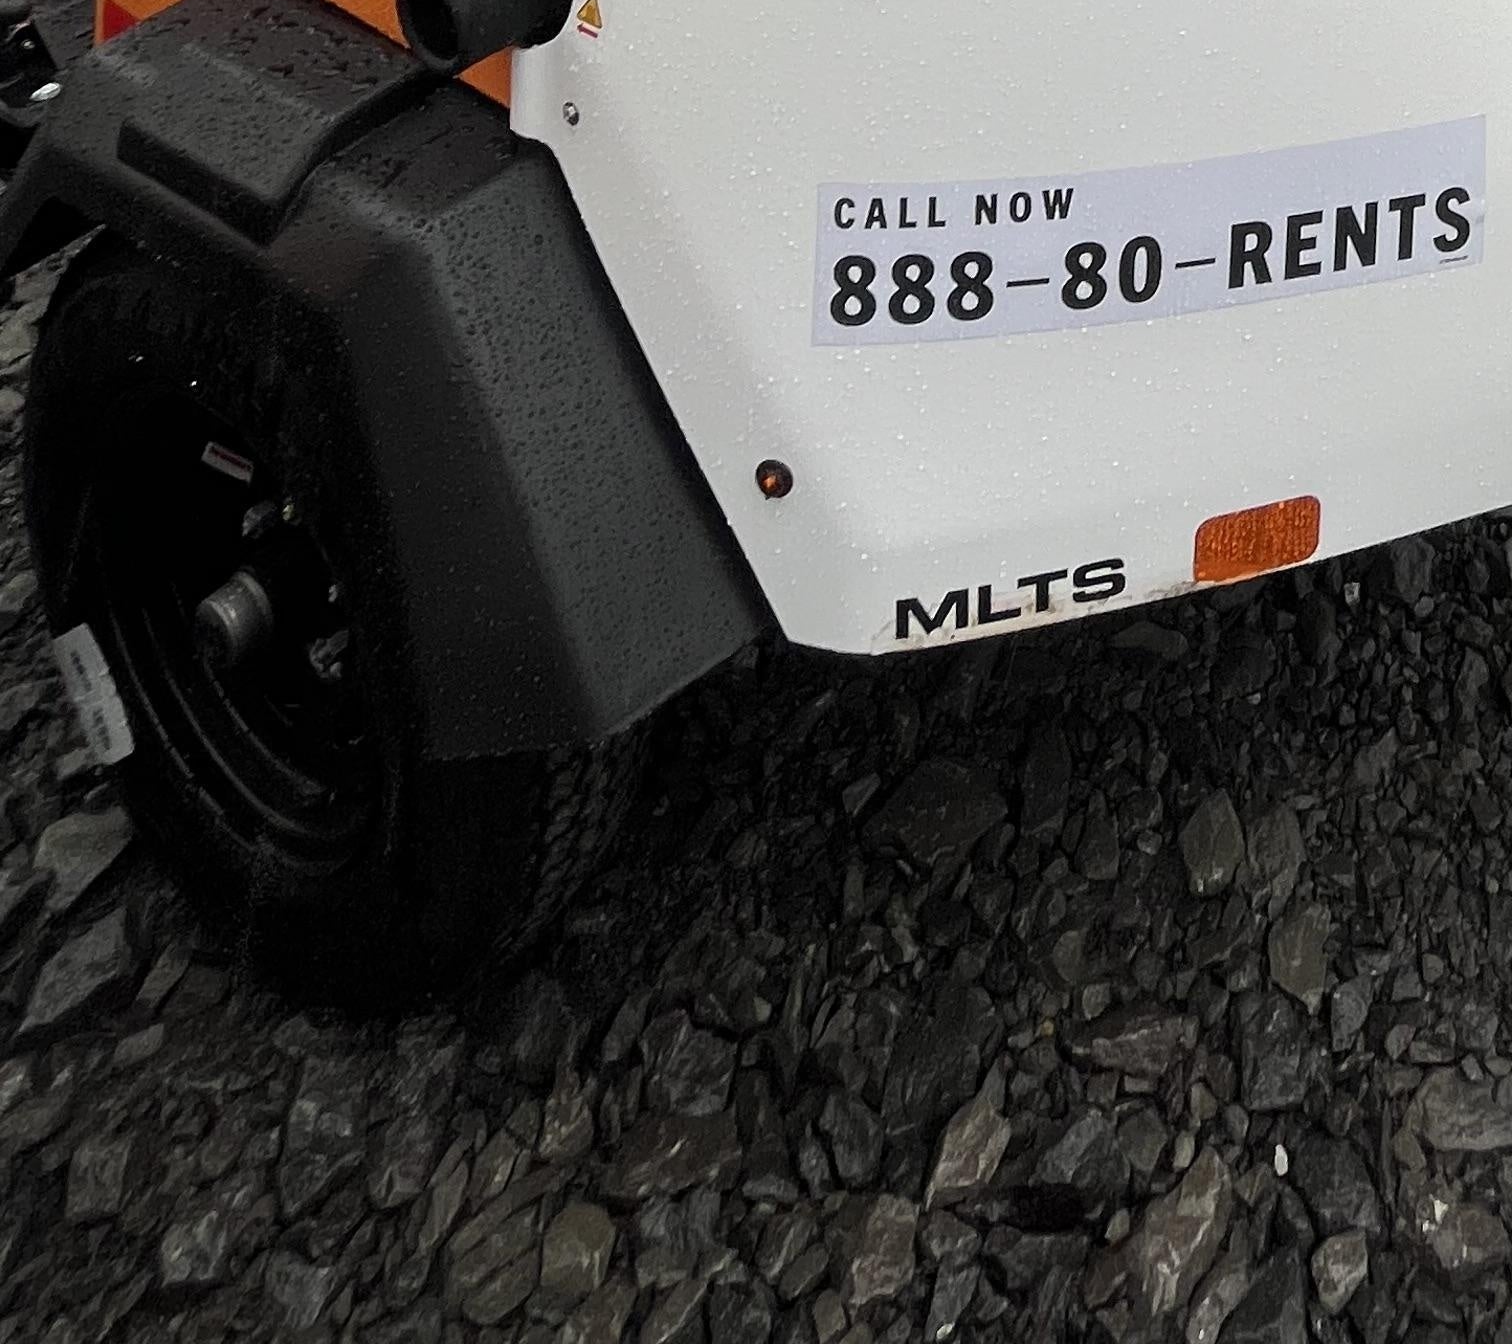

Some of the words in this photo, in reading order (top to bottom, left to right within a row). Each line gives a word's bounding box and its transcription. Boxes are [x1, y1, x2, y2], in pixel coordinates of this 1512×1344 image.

[834, 196, 946, 230] CALL
[975, 188, 1075, 227] NOW
[829, 186, 1473, 327] 888-80-RENTS
[895, 558, 1127, 640] MLTS
